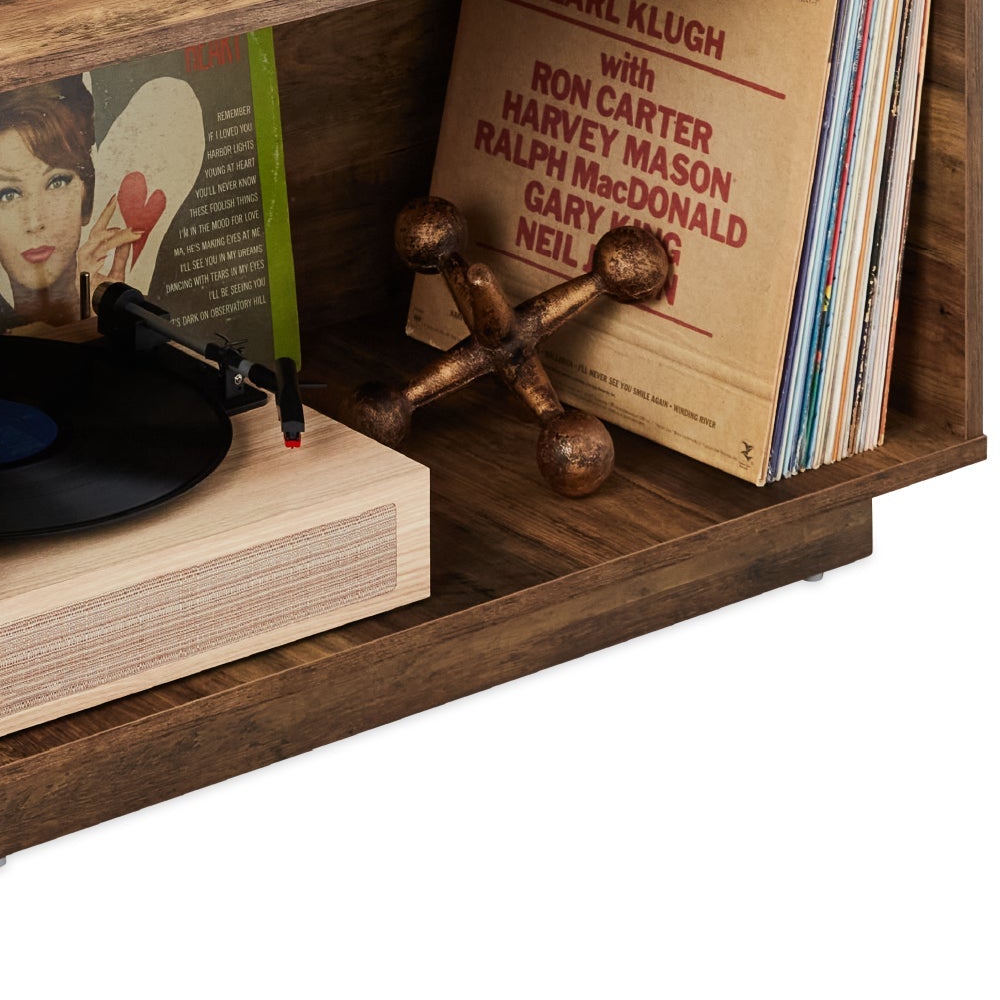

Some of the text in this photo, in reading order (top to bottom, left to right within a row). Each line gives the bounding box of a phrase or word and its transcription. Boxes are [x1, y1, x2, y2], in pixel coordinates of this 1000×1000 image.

[600, 51, 655, 93] with
[217, 105, 251, 121] REMEMBER
[531, 60, 713, 155] RON CARTER
[220, 125, 239, 139] LOVED
[240, 122, 253, 133] YOU
[207, 139, 254, 160] HARBOR LIGHTS
[502, 89, 732, 203] HARVEY MASON
[205, 157, 255, 178] YOUNG AT HEART
[218, 180, 237, 193] NEVER
[238, 175, 257, 188] KNOW
[474, 119, 748, 249] RALPH MacDONALD
[189, 192, 259, 218] THESE FOOLISH THINGS
[524, 180, 605, 235] GARY
[190, 226, 197, 235] IN
[198, 223, 210, 234] THE
[211, 217, 230, 231] MOOD
[231, 214, 243, 225] FOR
[244, 209, 260, 222] LOVE
[201, 237, 225, 251] MAKING
[226, 232, 241, 244] EYES
[242, 229, 250, 240] AT
[251, 227, 261, 238] ME
[515, 216, 578, 268] NEIL
[192, 258, 204, 270] SEE
[205, 255, 218, 266] YOU
[219, 253, 226, 262] IN
[226, 250, 237, 260] MY
[237, 244, 263, 258] DREAMS
[166, 259, 265, 294] DANCING WITH TEARS IN MY EYES
[221, 286, 229, 298] BE
[230, 281, 253, 295] SEEING
[253, 277, 266, 289] YOU
[182, 313, 199, 326] DARK
[200, 310, 209, 321] ON
[210, 300, 252, 318] OBSERVATORY
[253, 295, 267, 308] HILL
[589, 369, 608, 383] NEVER
[608, 376, 619, 388] SEE
[620, 382, 632, 393] YOU
[633, 387, 650, 400] SMILE
[651, 395, 669, 408] AGAIN
[673, 403, 699, 422] WINDING
[699, 415, 717, 429] RIVER
